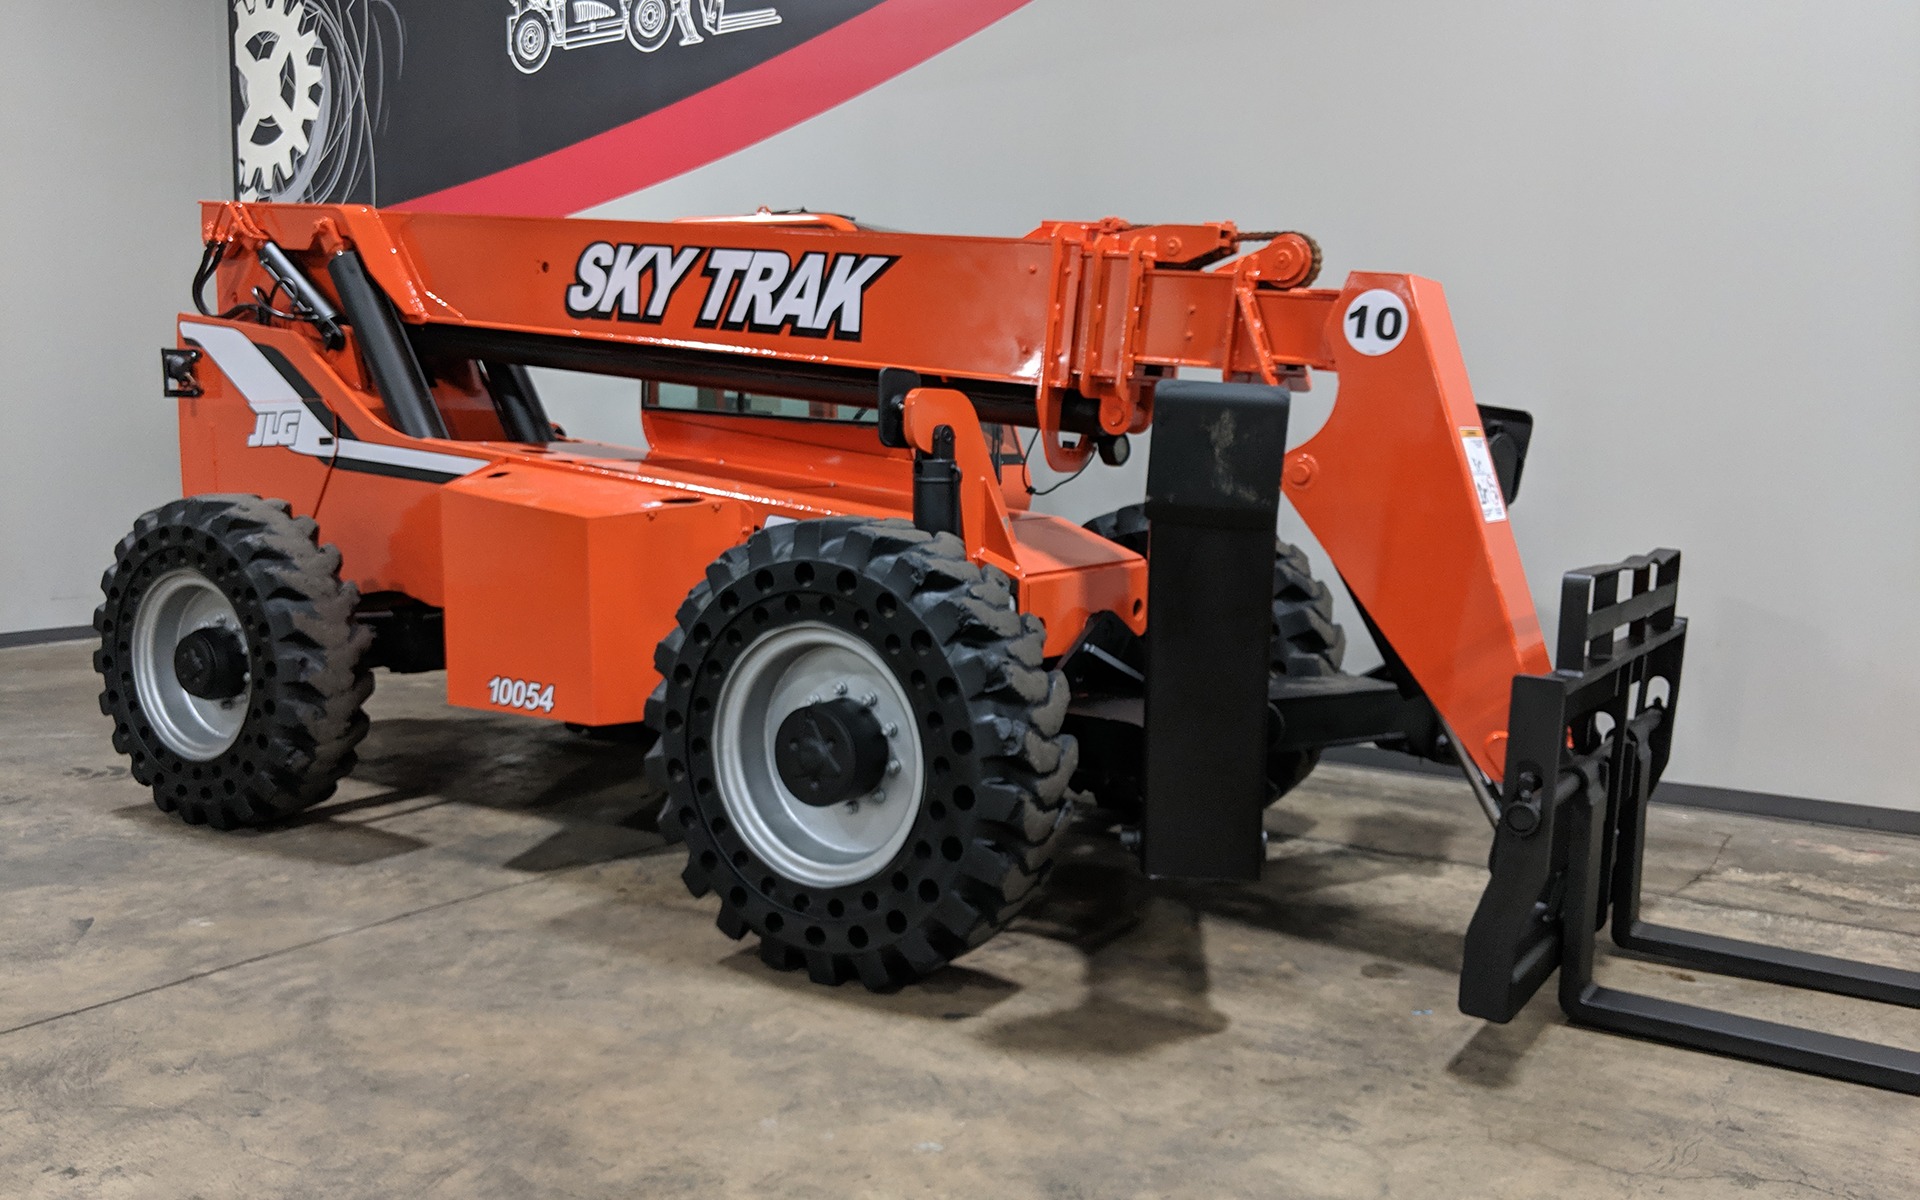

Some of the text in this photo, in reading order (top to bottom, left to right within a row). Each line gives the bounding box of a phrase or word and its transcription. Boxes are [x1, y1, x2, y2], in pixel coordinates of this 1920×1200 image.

[566, 241, 898, 339] SKY TRAK
[1348, 305, 1402, 341] 10
[247, 410, 301, 447] JLG
[488, 676, 555, 713] 10054
